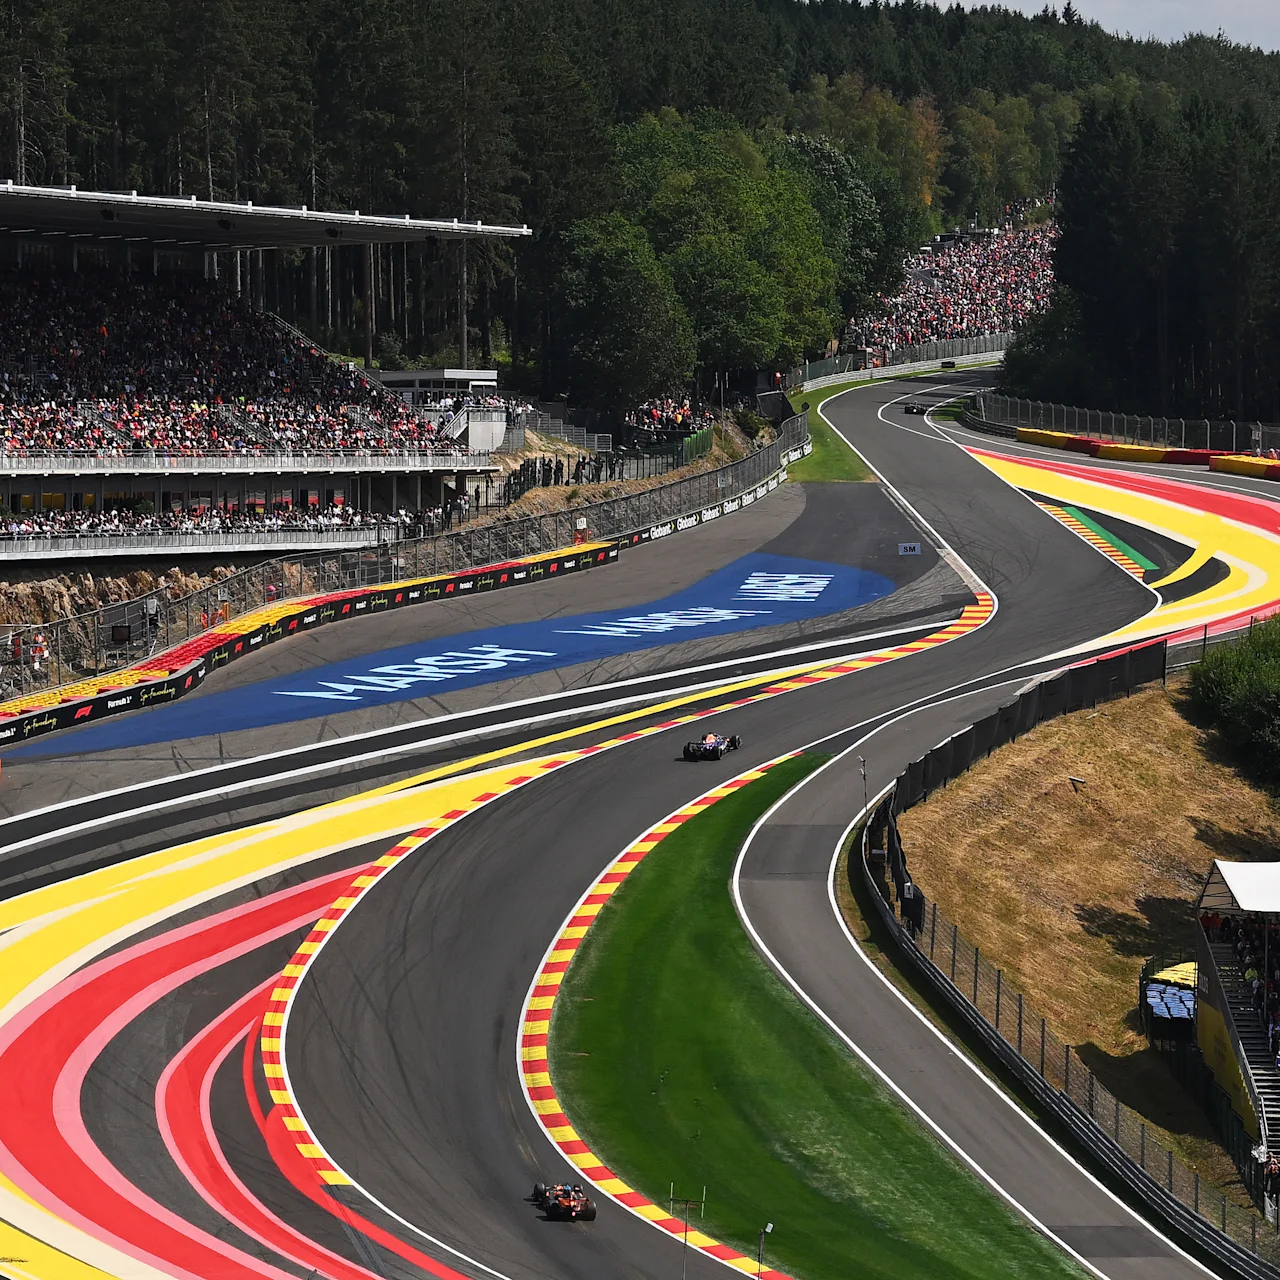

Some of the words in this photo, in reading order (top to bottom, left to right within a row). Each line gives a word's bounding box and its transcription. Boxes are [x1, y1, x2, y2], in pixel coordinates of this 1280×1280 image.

[702, 506, 719, 522] Globant
[723, 498, 738, 514] Globant
[677, 514, 696, 530] Globant
[650, 523, 671, 539] Globant
[731, 572, 834, 601] MARSH
[552, 606, 772, 637] MARSH
[271, 644, 558, 700] MARSH
[108, 698, 126, 709] Formula
